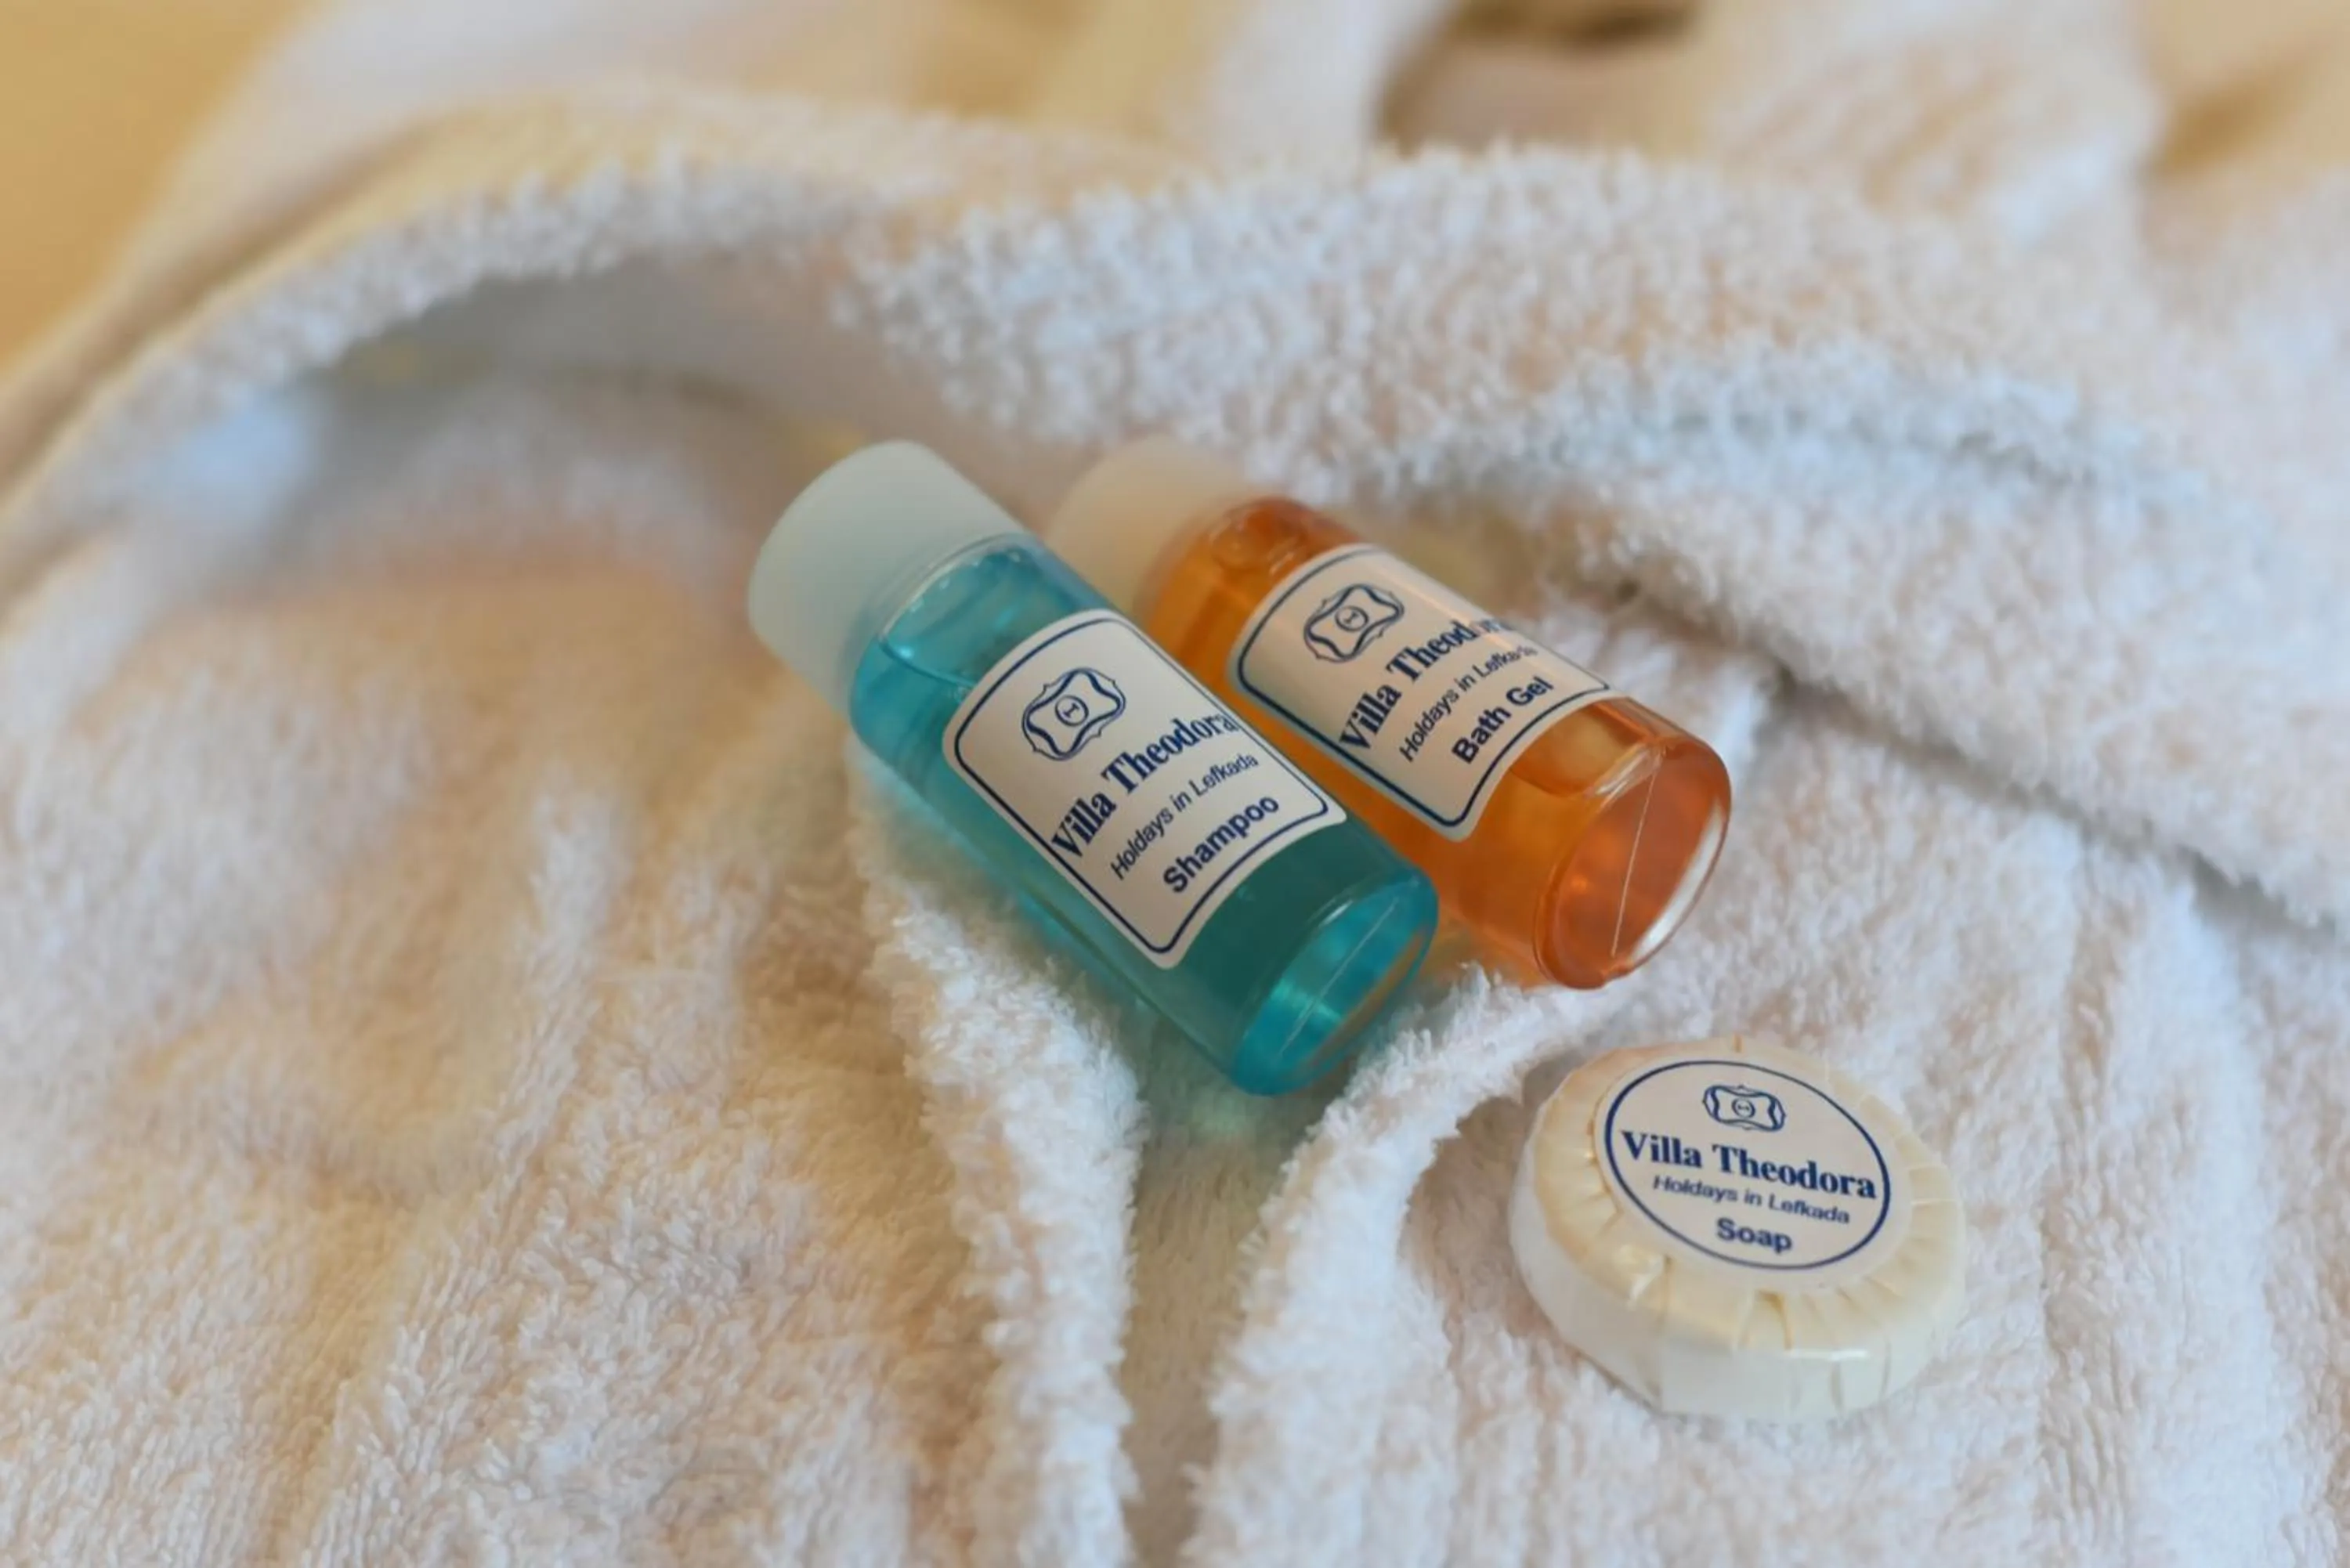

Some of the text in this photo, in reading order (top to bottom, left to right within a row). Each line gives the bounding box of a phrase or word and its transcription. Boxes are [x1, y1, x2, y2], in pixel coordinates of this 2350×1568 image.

[1454, 674, 1477, 692] in
[1339, 684, 1402, 750] Villa
[1452, 675, 1554, 765] Bath Gel
[1051, 714, 1238, 858] Villa Theodora
[1170, 793, 1193, 813] in
[1188, 753, 1259, 797] Lefkada
[1163, 797, 1279, 894] Shampoo
[1621, 1130, 1877, 1200] Villa Theodora
[1716, 1216, 1793, 1253] Soap
[1744, 1188, 1762, 1208] in
[1768, 1194, 1850, 1224] Lefkada
